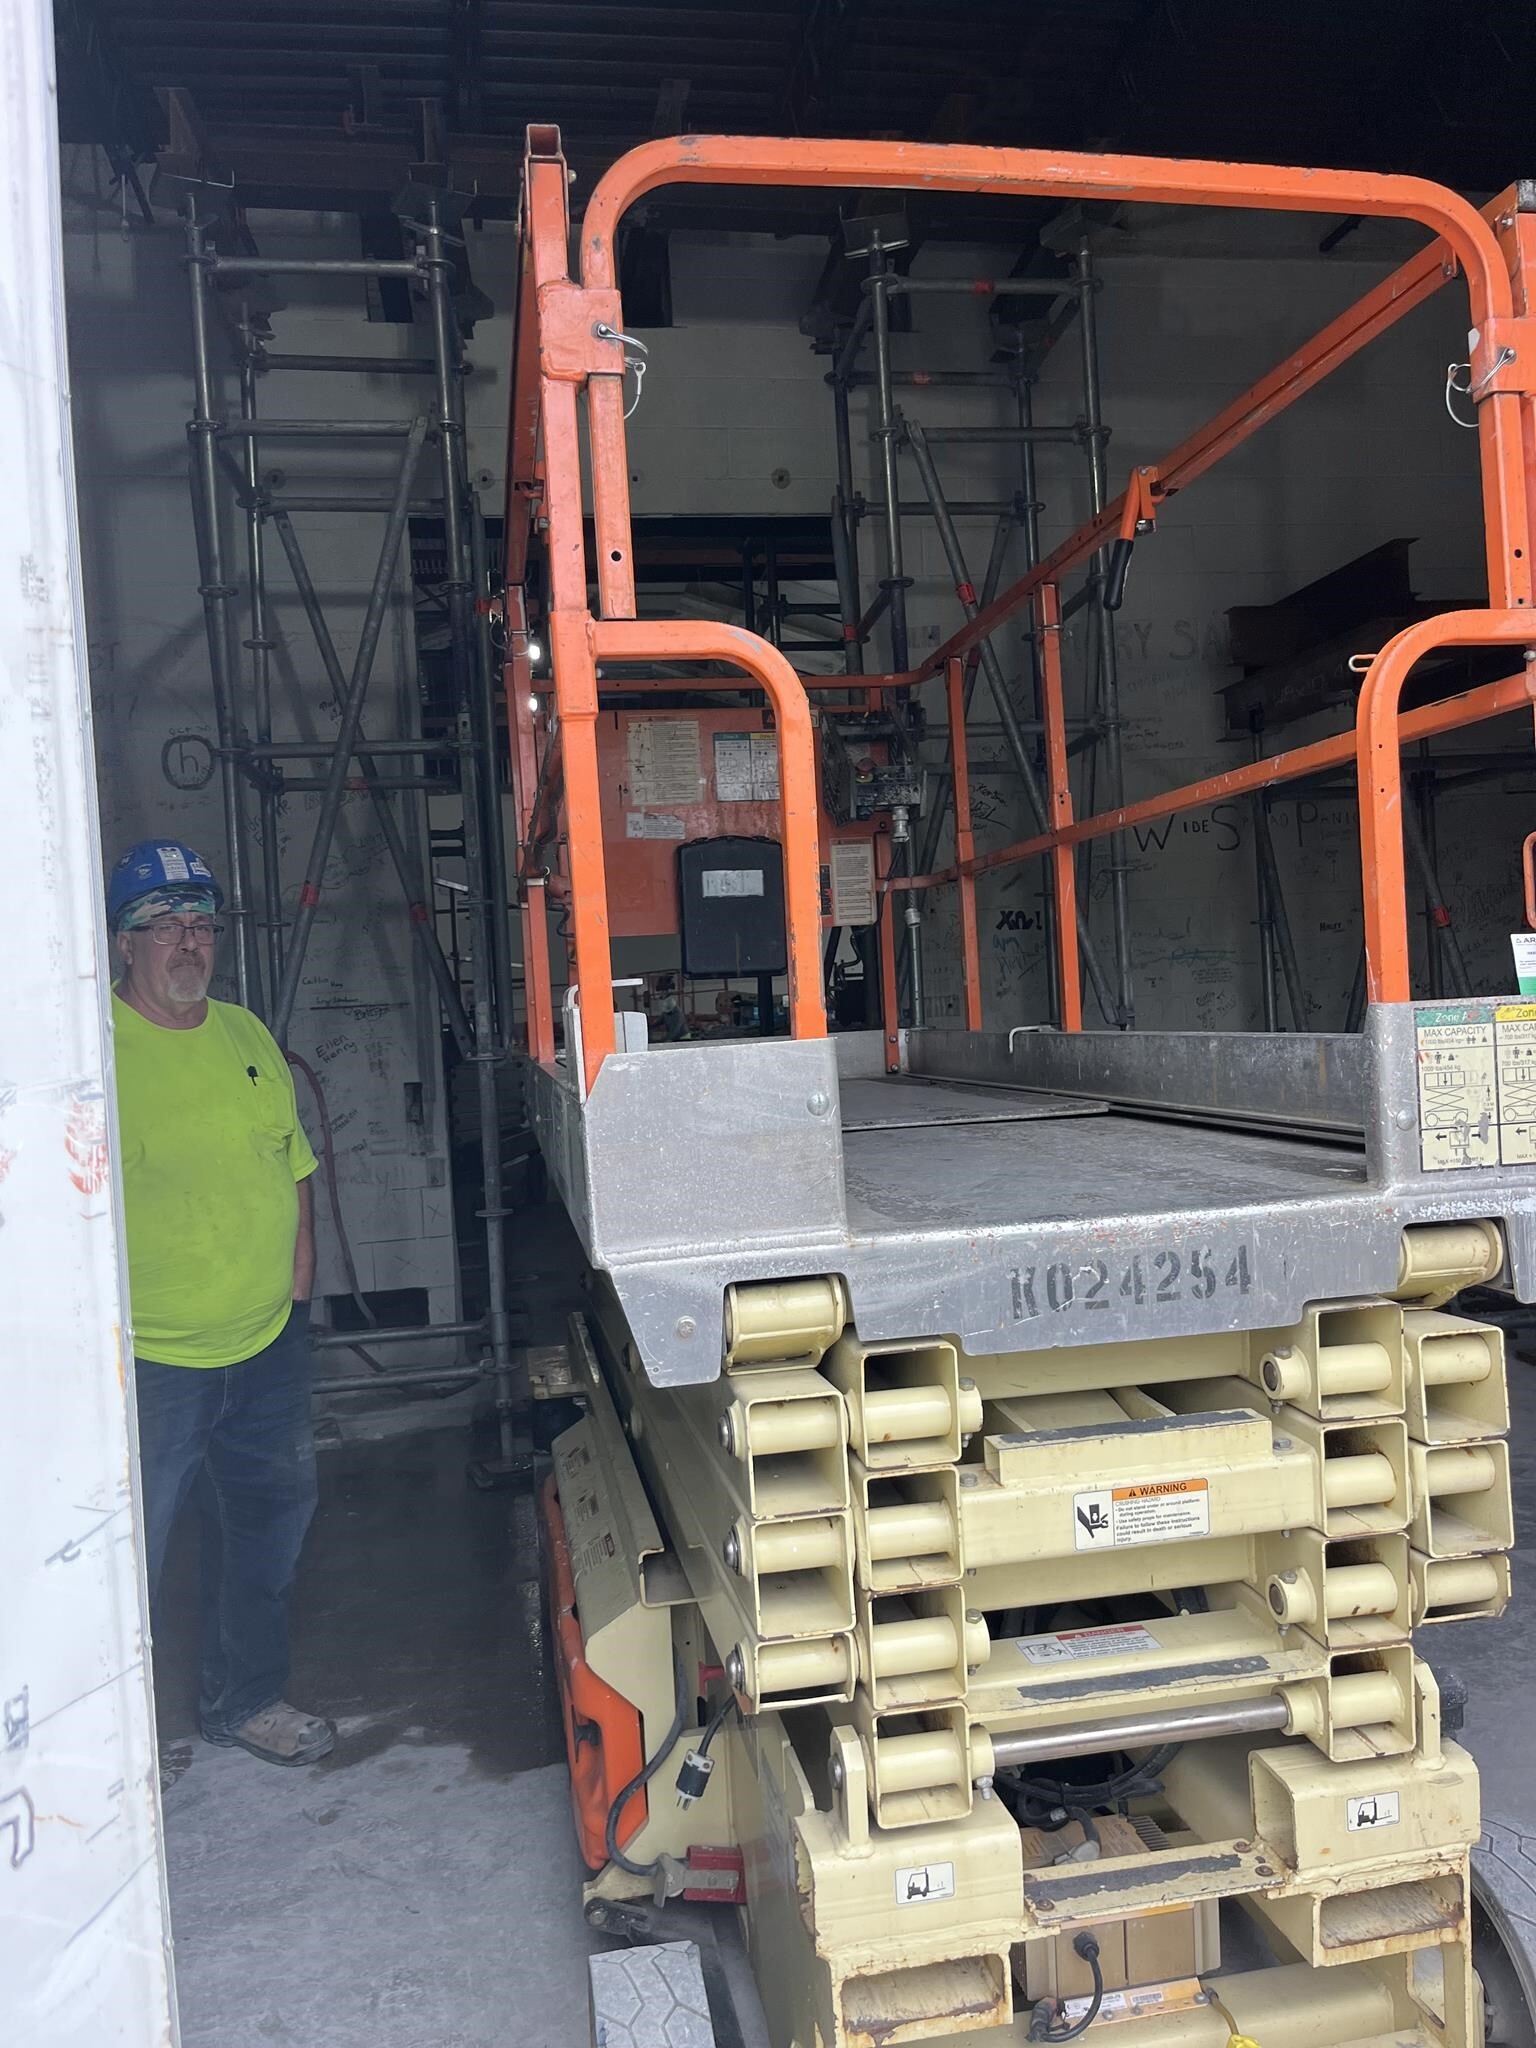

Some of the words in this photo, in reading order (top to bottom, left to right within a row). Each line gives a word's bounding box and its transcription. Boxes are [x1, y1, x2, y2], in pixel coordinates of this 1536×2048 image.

[1435, 1013, 1459, 1023] Zone
[1516, 1008, 1536, 1018] Zon
[1424, 1028, 1443, 1038] MAX
[1444, 1026, 1487, 1037] CAPACITY
[1502, 1024, 1521, 1033] MAX
[1140, 1482, 1187, 1496] WARNING
[1084, 1628, 1125, 1637] DANGER
